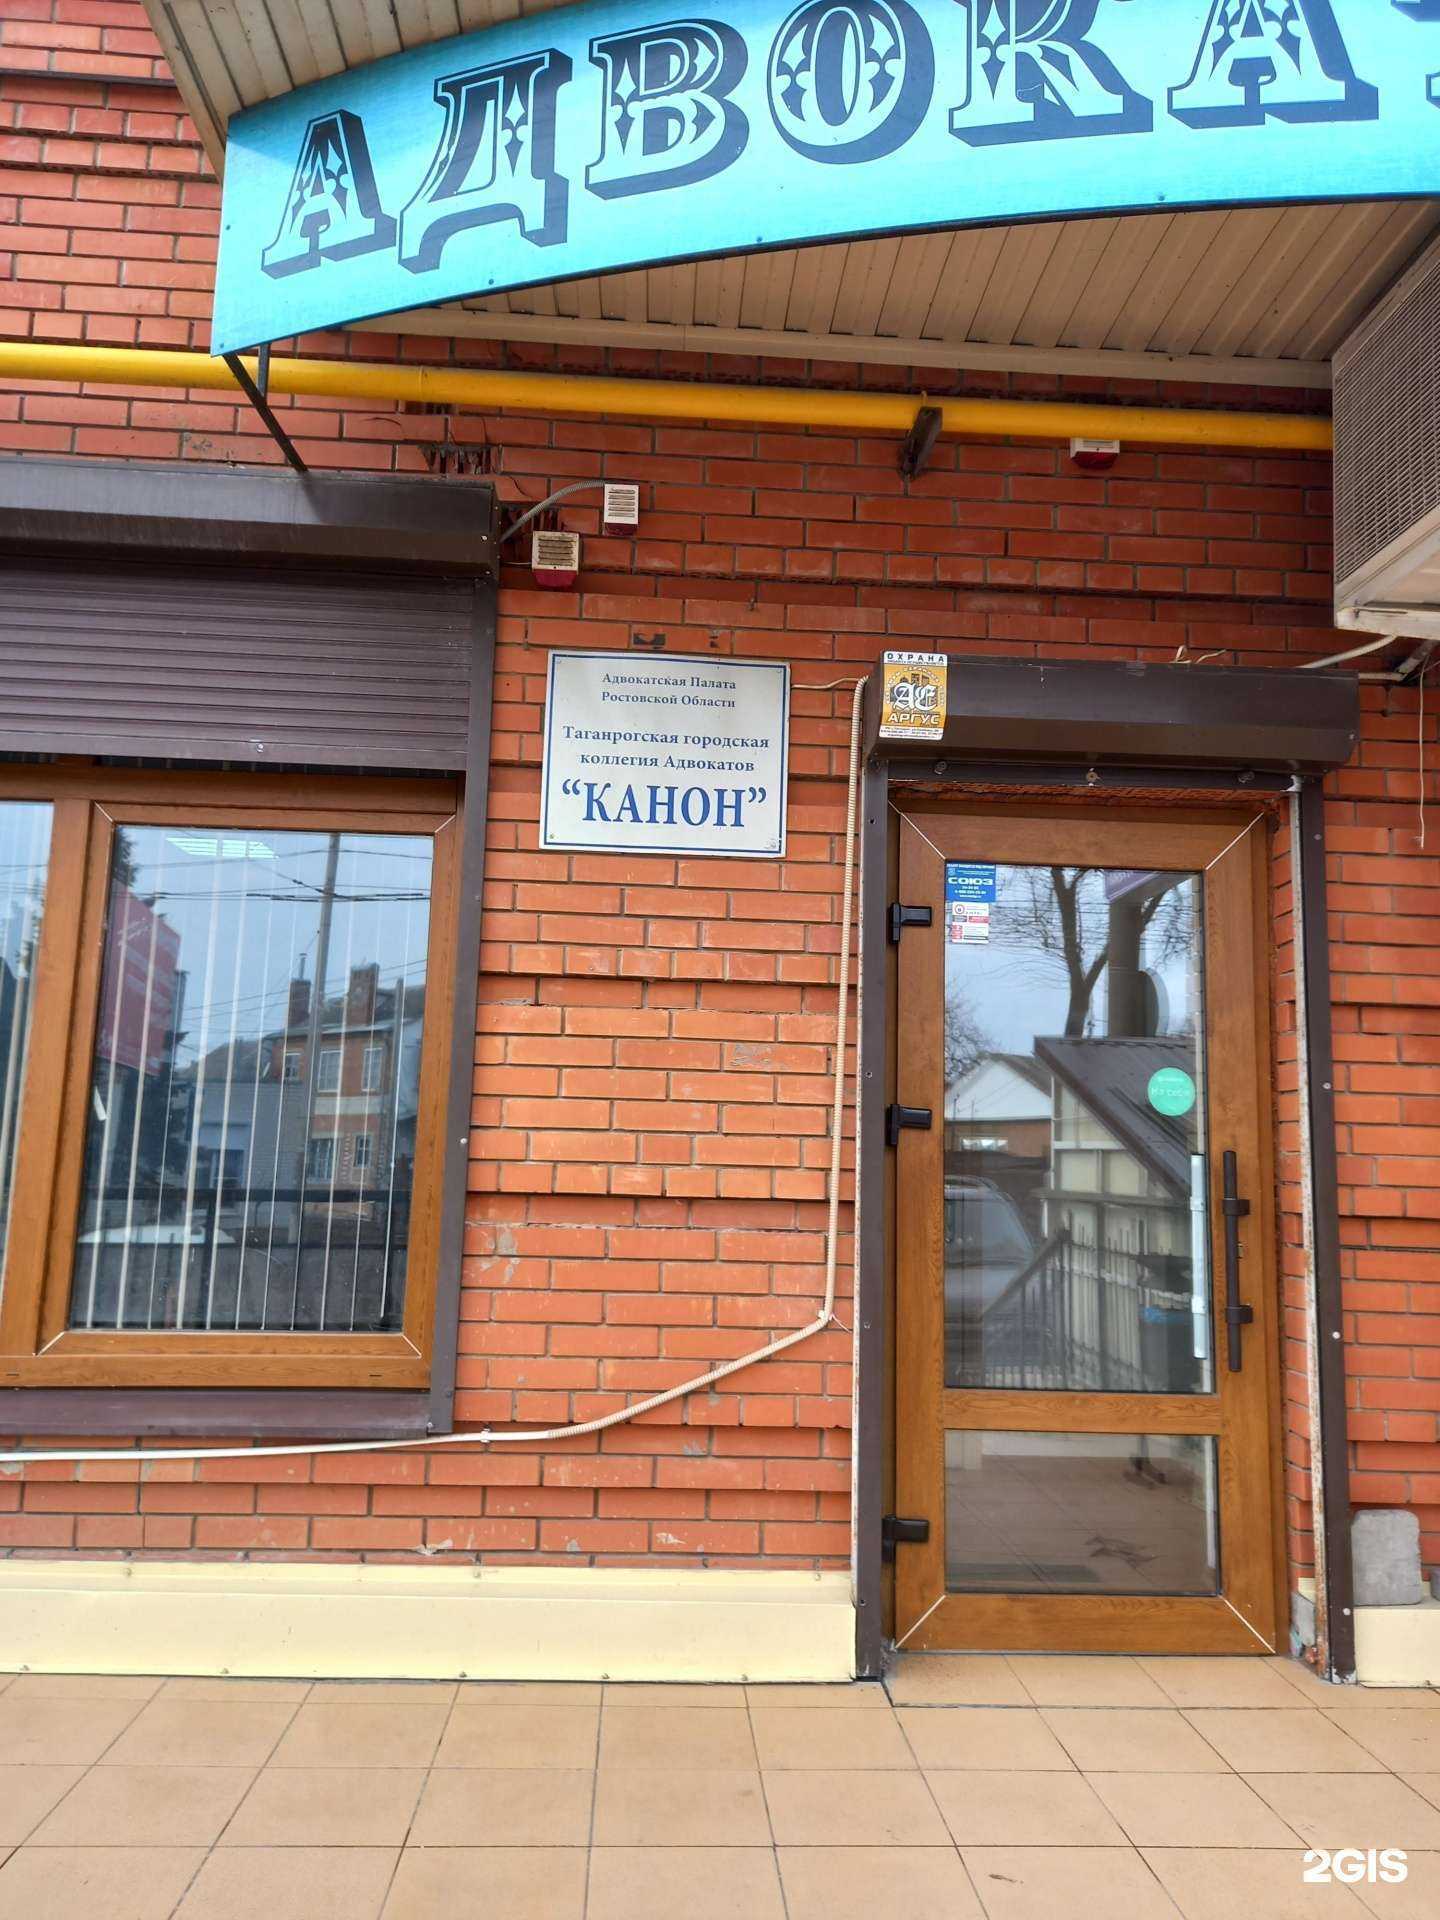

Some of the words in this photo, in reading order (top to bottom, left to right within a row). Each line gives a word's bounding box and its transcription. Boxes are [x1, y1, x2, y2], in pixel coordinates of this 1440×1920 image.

[260, 0, 1440, 279] АДВОКА
[887, 652, 944, 662] ОХРАНА
[602, 673, 686, 687] Адвокатская
[690, 676, 736, 690] Палата
[601, 691, 678, 705] Ростовской
[681, 693, 736, 708] Области
[887, 712, 941, 725] АРГУС
[562, 725, 679, 745] Таганрогская
[683, 735, 769, 749] городская
[580, 753, 659, 768] коллегия
[662, 755, 755, 772] Адвокатов
[947, 877, 994, 886] СОЮЗ
